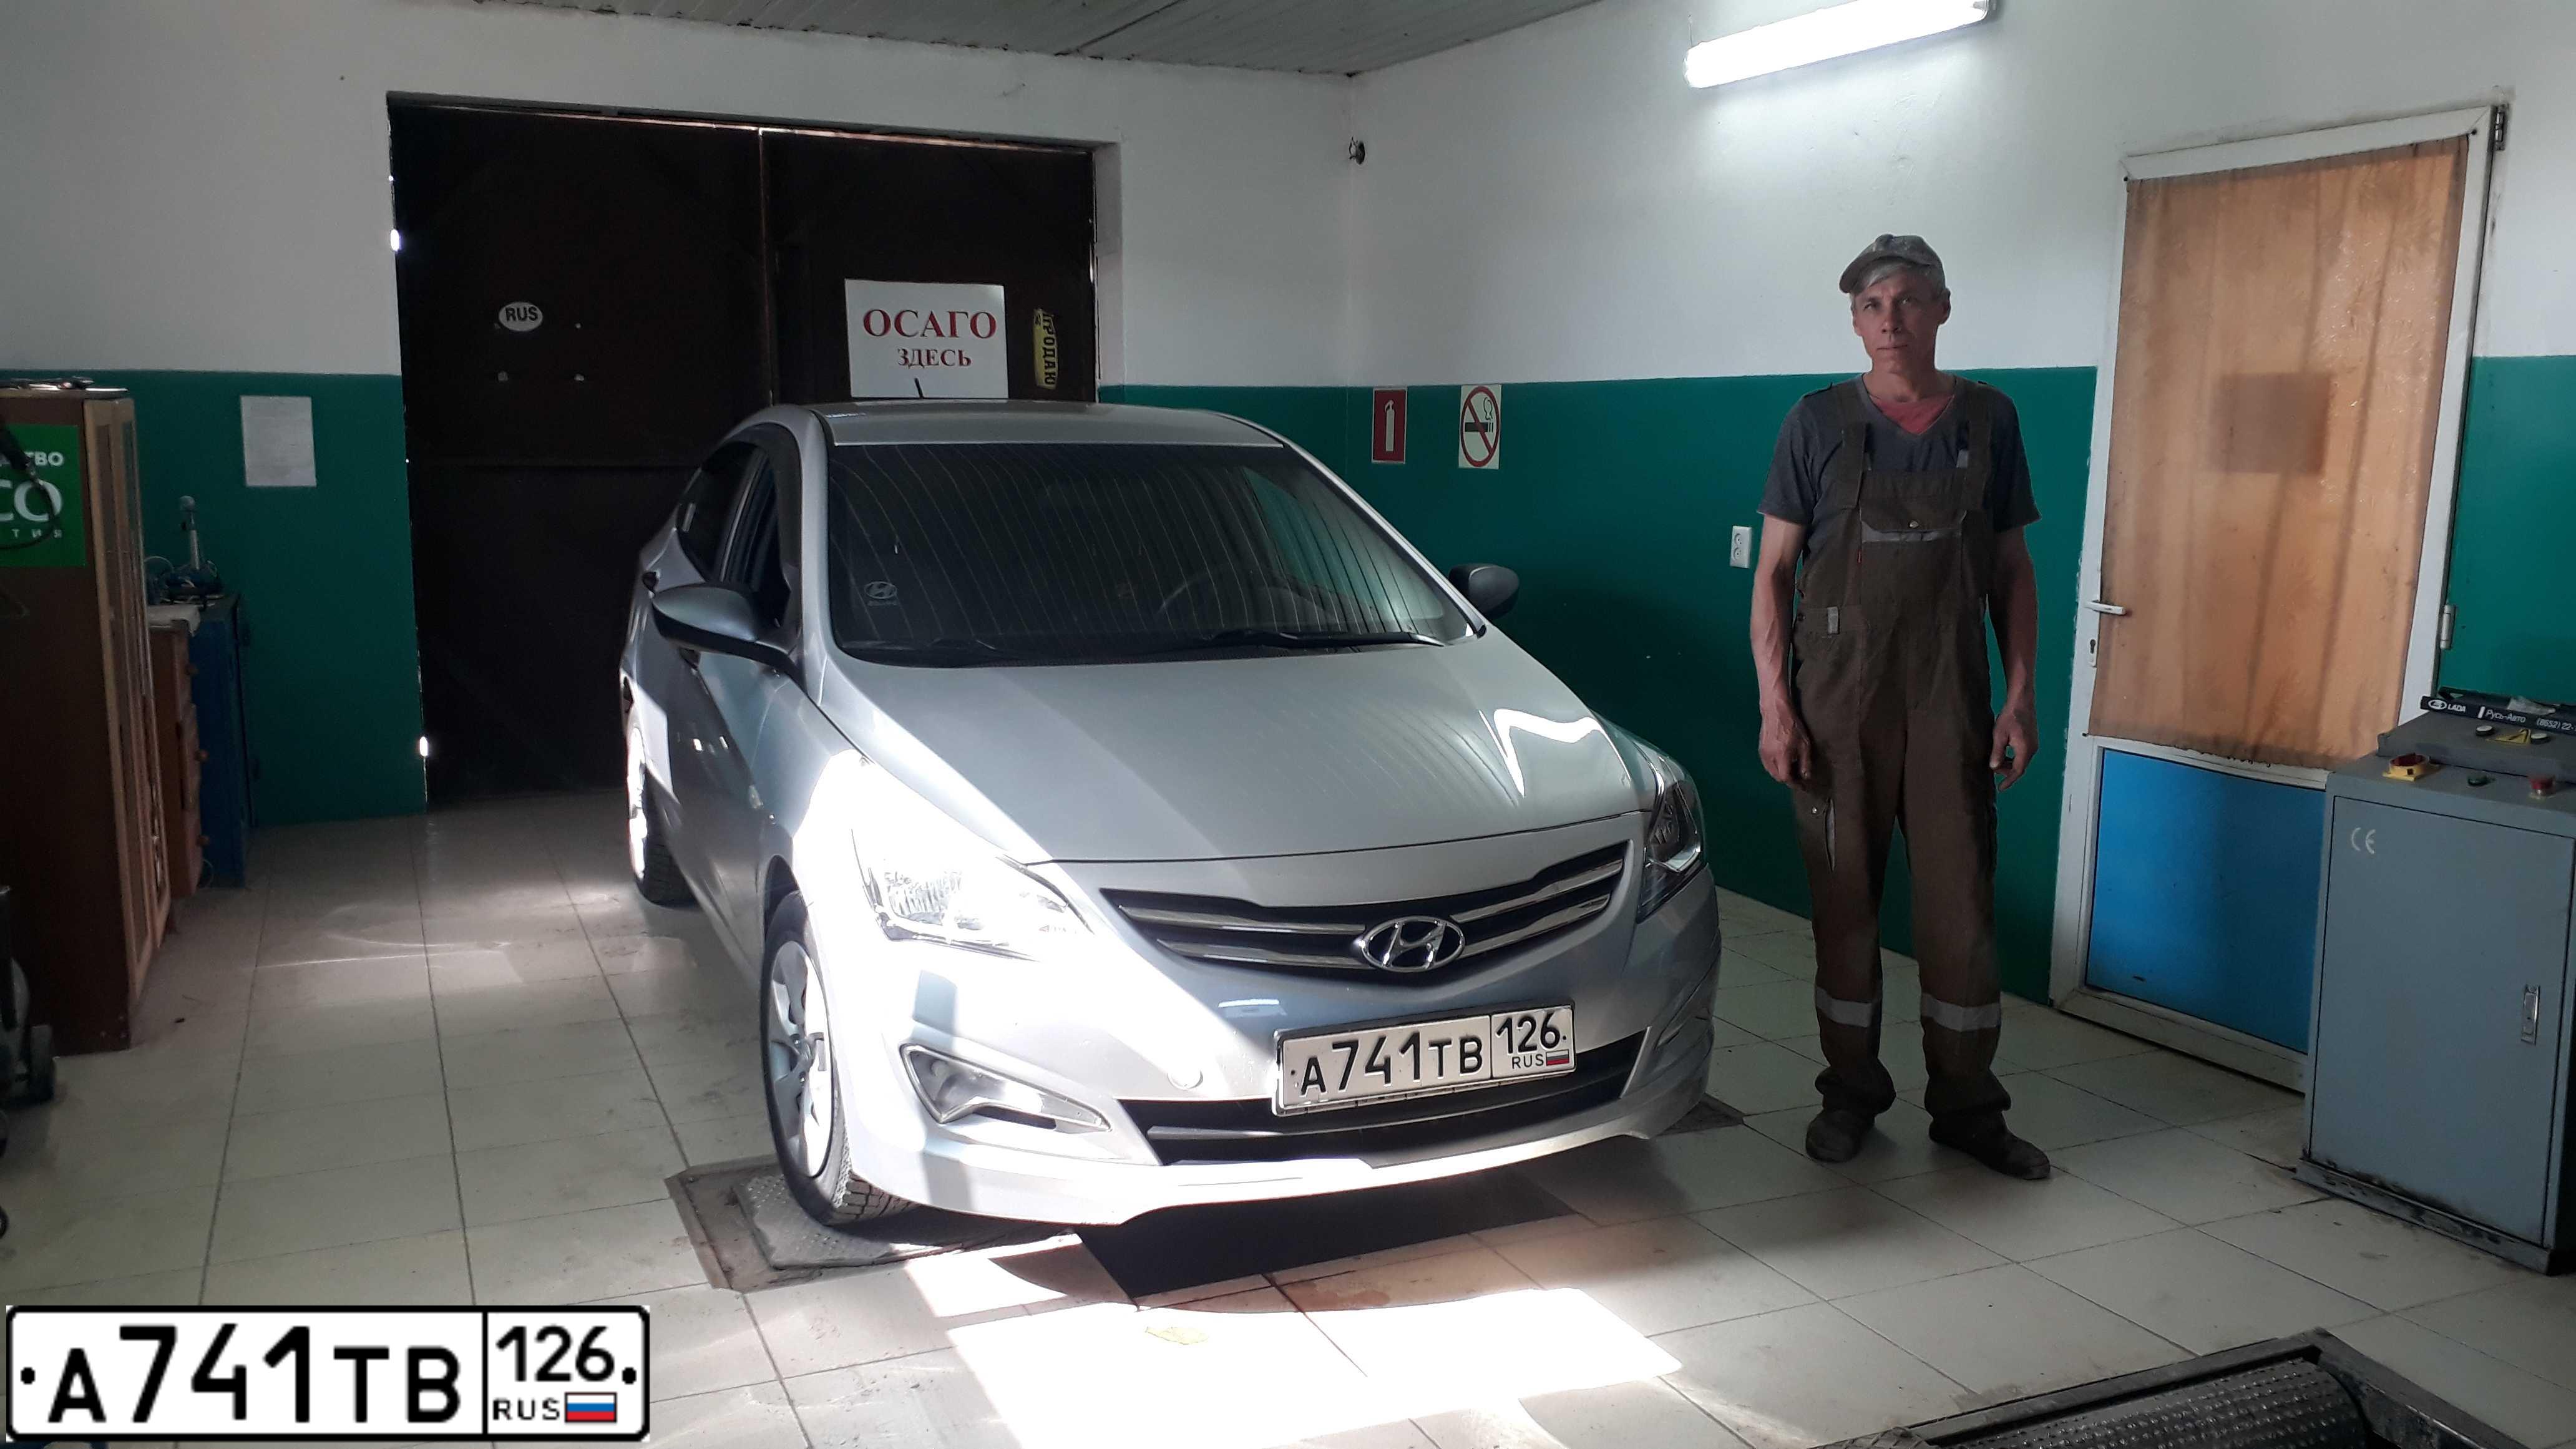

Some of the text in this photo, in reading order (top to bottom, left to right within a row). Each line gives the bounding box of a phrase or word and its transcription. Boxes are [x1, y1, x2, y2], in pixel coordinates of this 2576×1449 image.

[505, 306, 538, 321] RUS
[863, 309, 997, 339] ОСАГО
[897, 348, 972, 369] ЗДЕСЬ
[1042, 313, 1056, 385] ПРОДАЮ
[2447, 703, 2467, 713] LADA
[2485, 709, 2527, 723] Русь-Авто
[1300, 1012, 1561, 1096] А741ТВ 126
[1511, 1053, 1544, 1070] RUS
